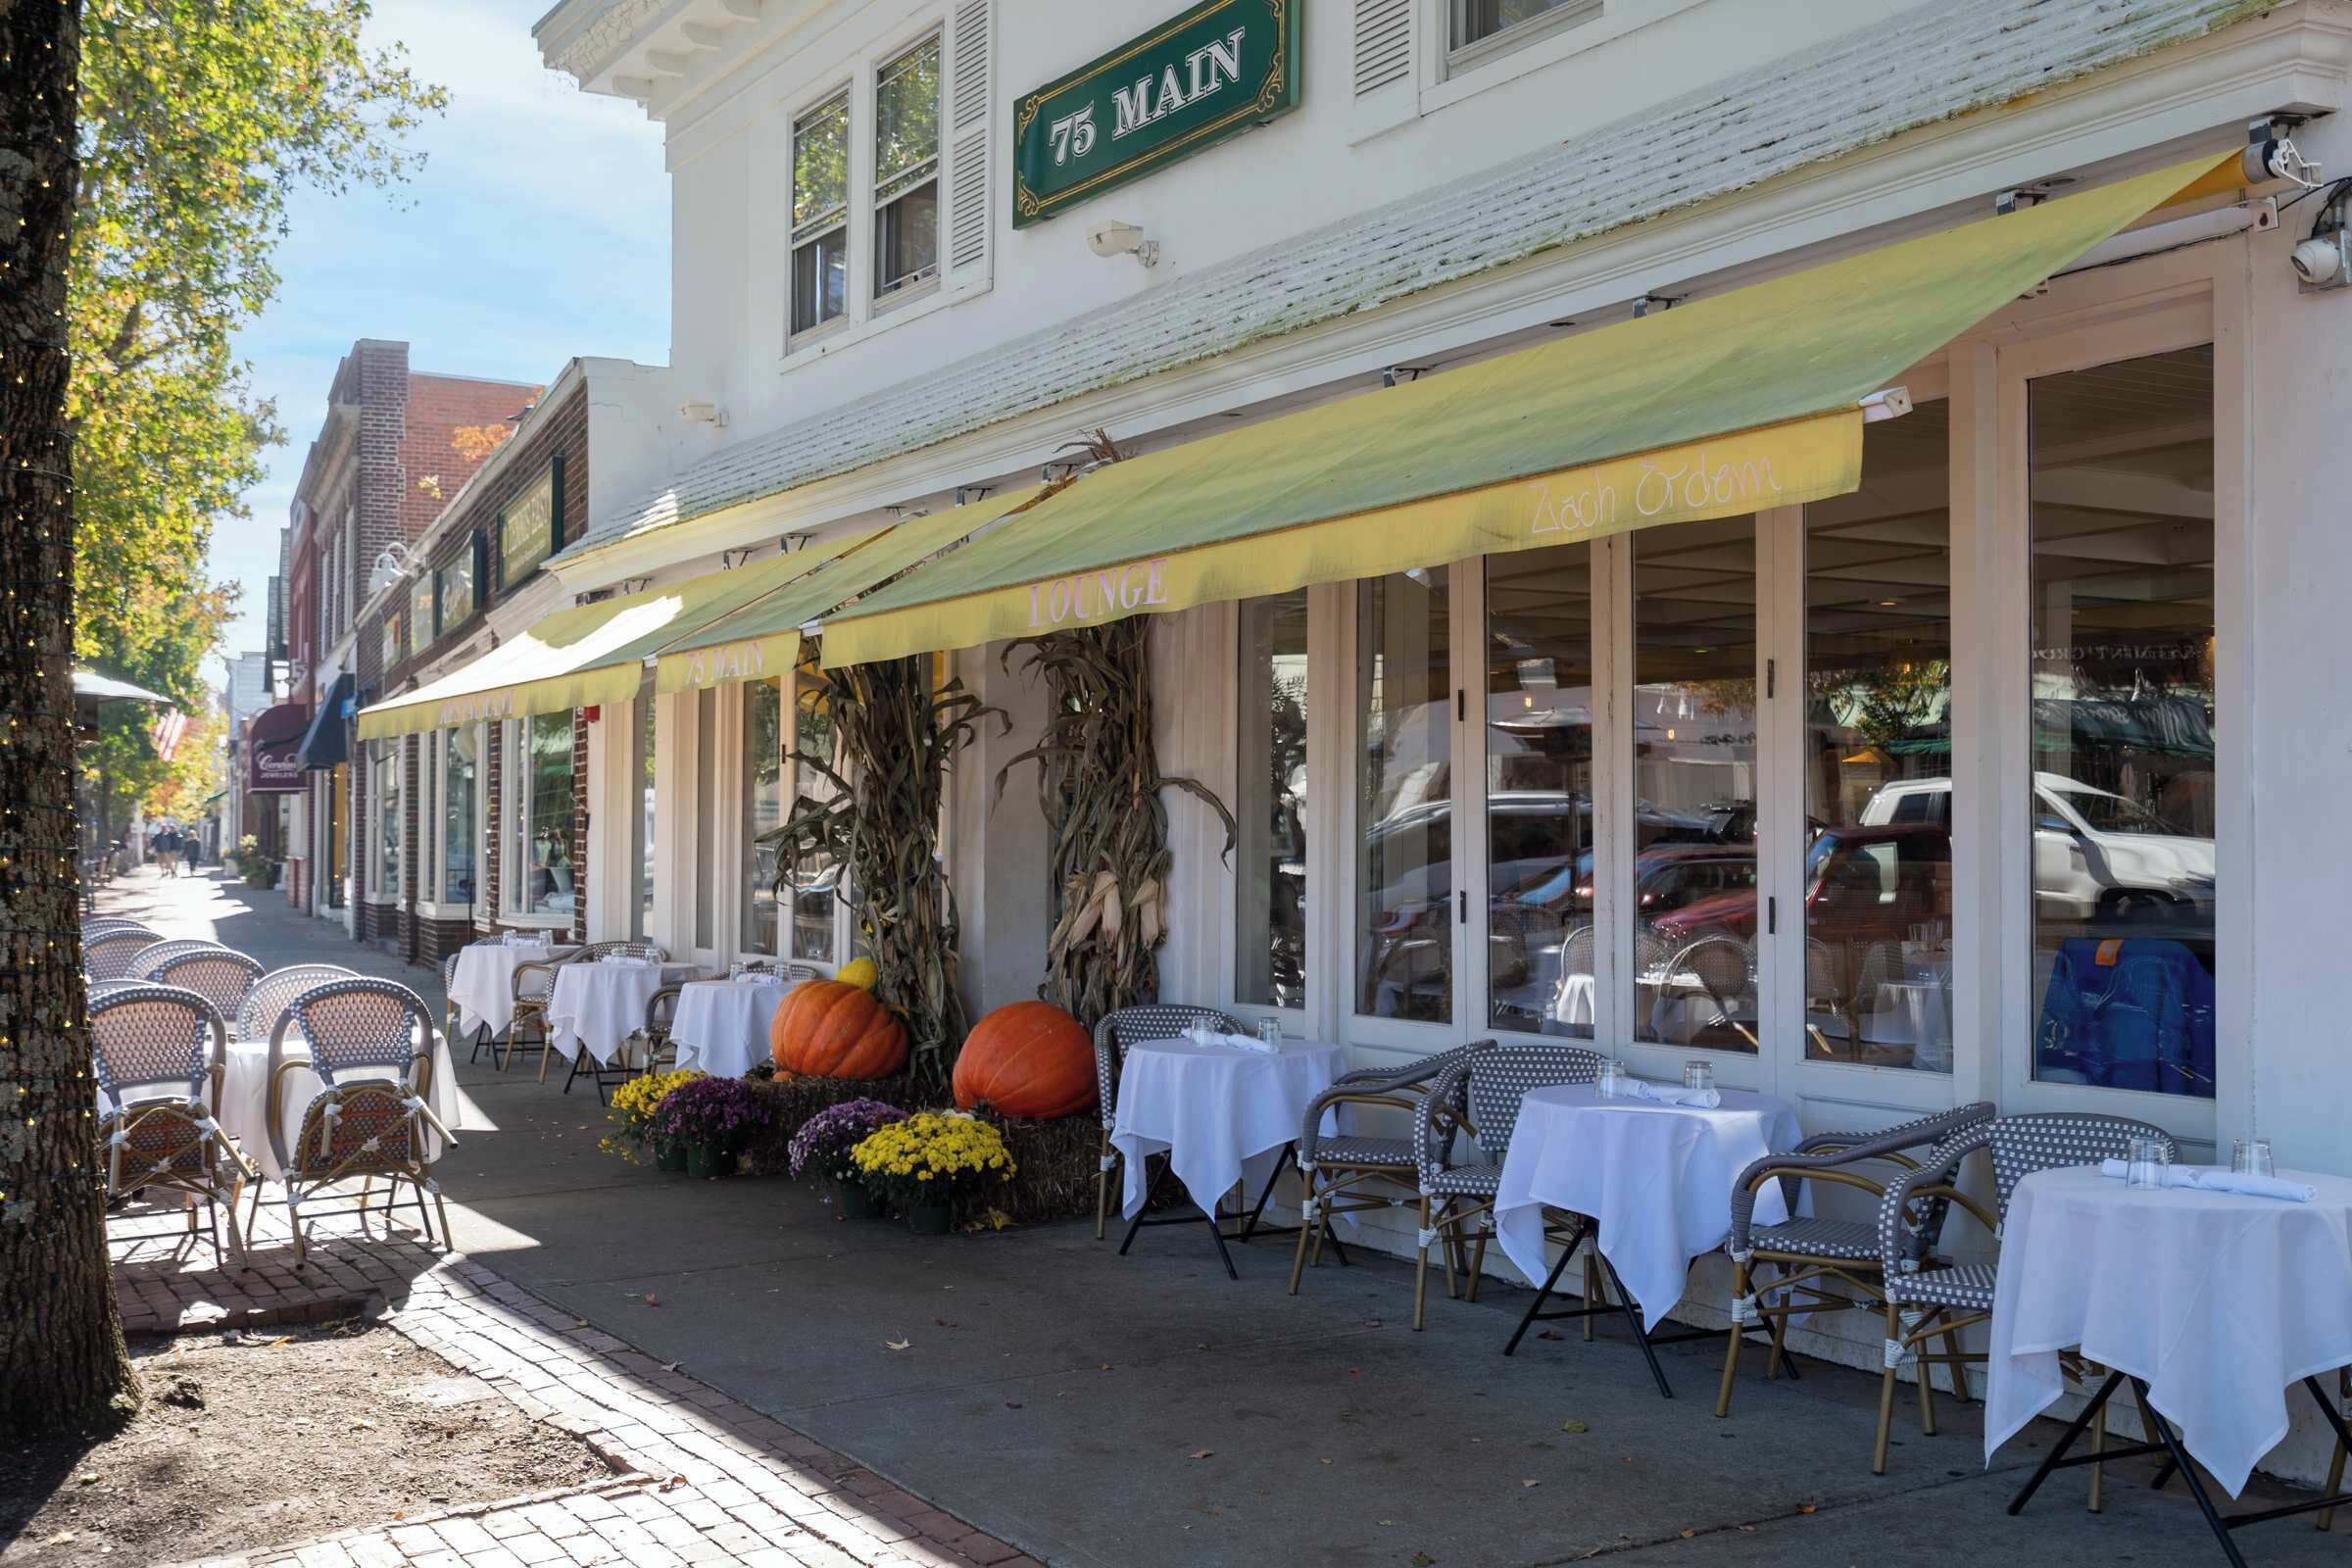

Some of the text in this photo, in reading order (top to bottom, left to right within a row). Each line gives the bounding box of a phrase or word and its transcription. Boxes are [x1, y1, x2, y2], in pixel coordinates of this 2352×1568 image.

[1050, 26, 1246, 166] 75 MAIN
[1528, 467, 1615, 533] Zach
[1030, 559, 1168, 627] LOUNGE
[686, 642, 767, 685] 75 MAIN
